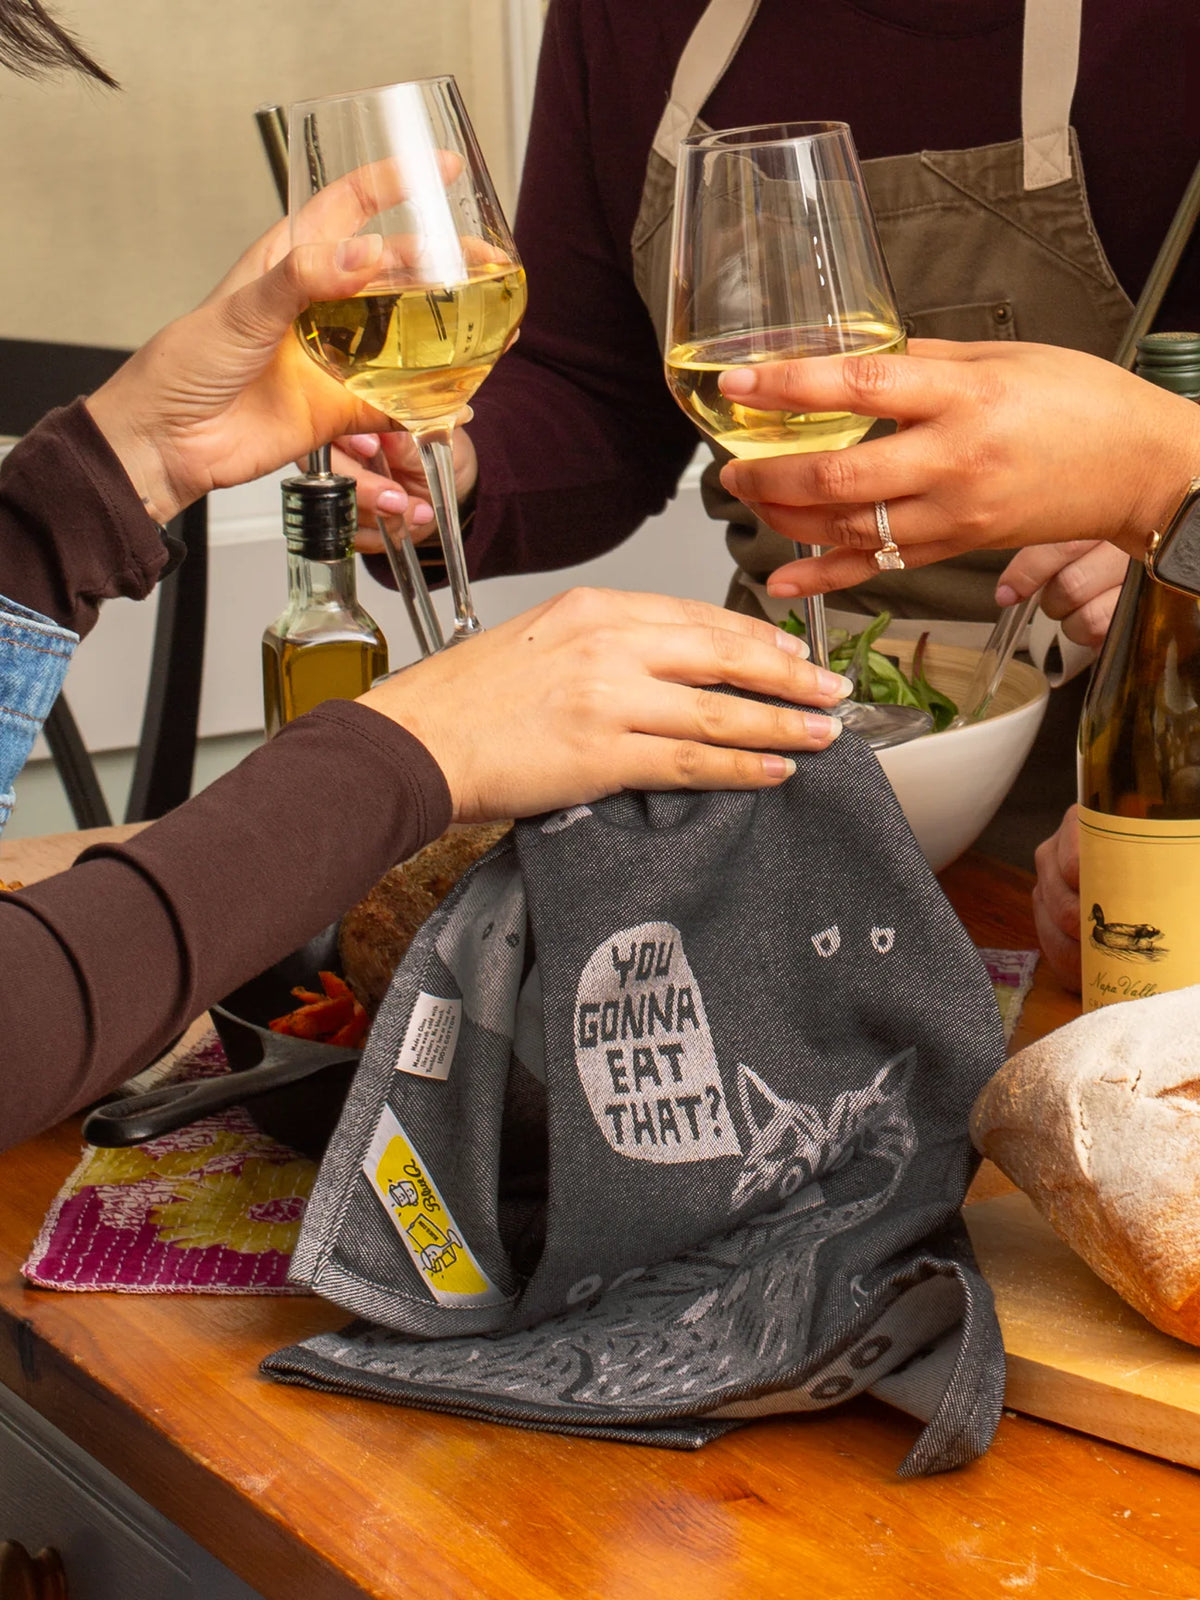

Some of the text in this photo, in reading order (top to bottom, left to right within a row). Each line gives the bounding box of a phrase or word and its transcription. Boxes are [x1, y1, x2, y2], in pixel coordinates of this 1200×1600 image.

[612, 942, 674, 988] YOU
[1089, 972, 1161, 997] Napa Valle
[411, 1038, 420, 1051] Made
[418, 1018, 427, 1031] China
[579, 983, 700, 1050] GONNA
[412, 1046, 424, 1067] Machine
[420, 1057, 428, 1067] like
[426, 1055, 437, 1072] Tumble
[433, 1045, 442, 1053] dry
[437, 1016, 455, 1064] 100% COTTON
[607, 1042, 683, 1094] EAT
[606, 1085, 723, 1146] THAT?
[403, 1159, 440, 1212] Blue Q
